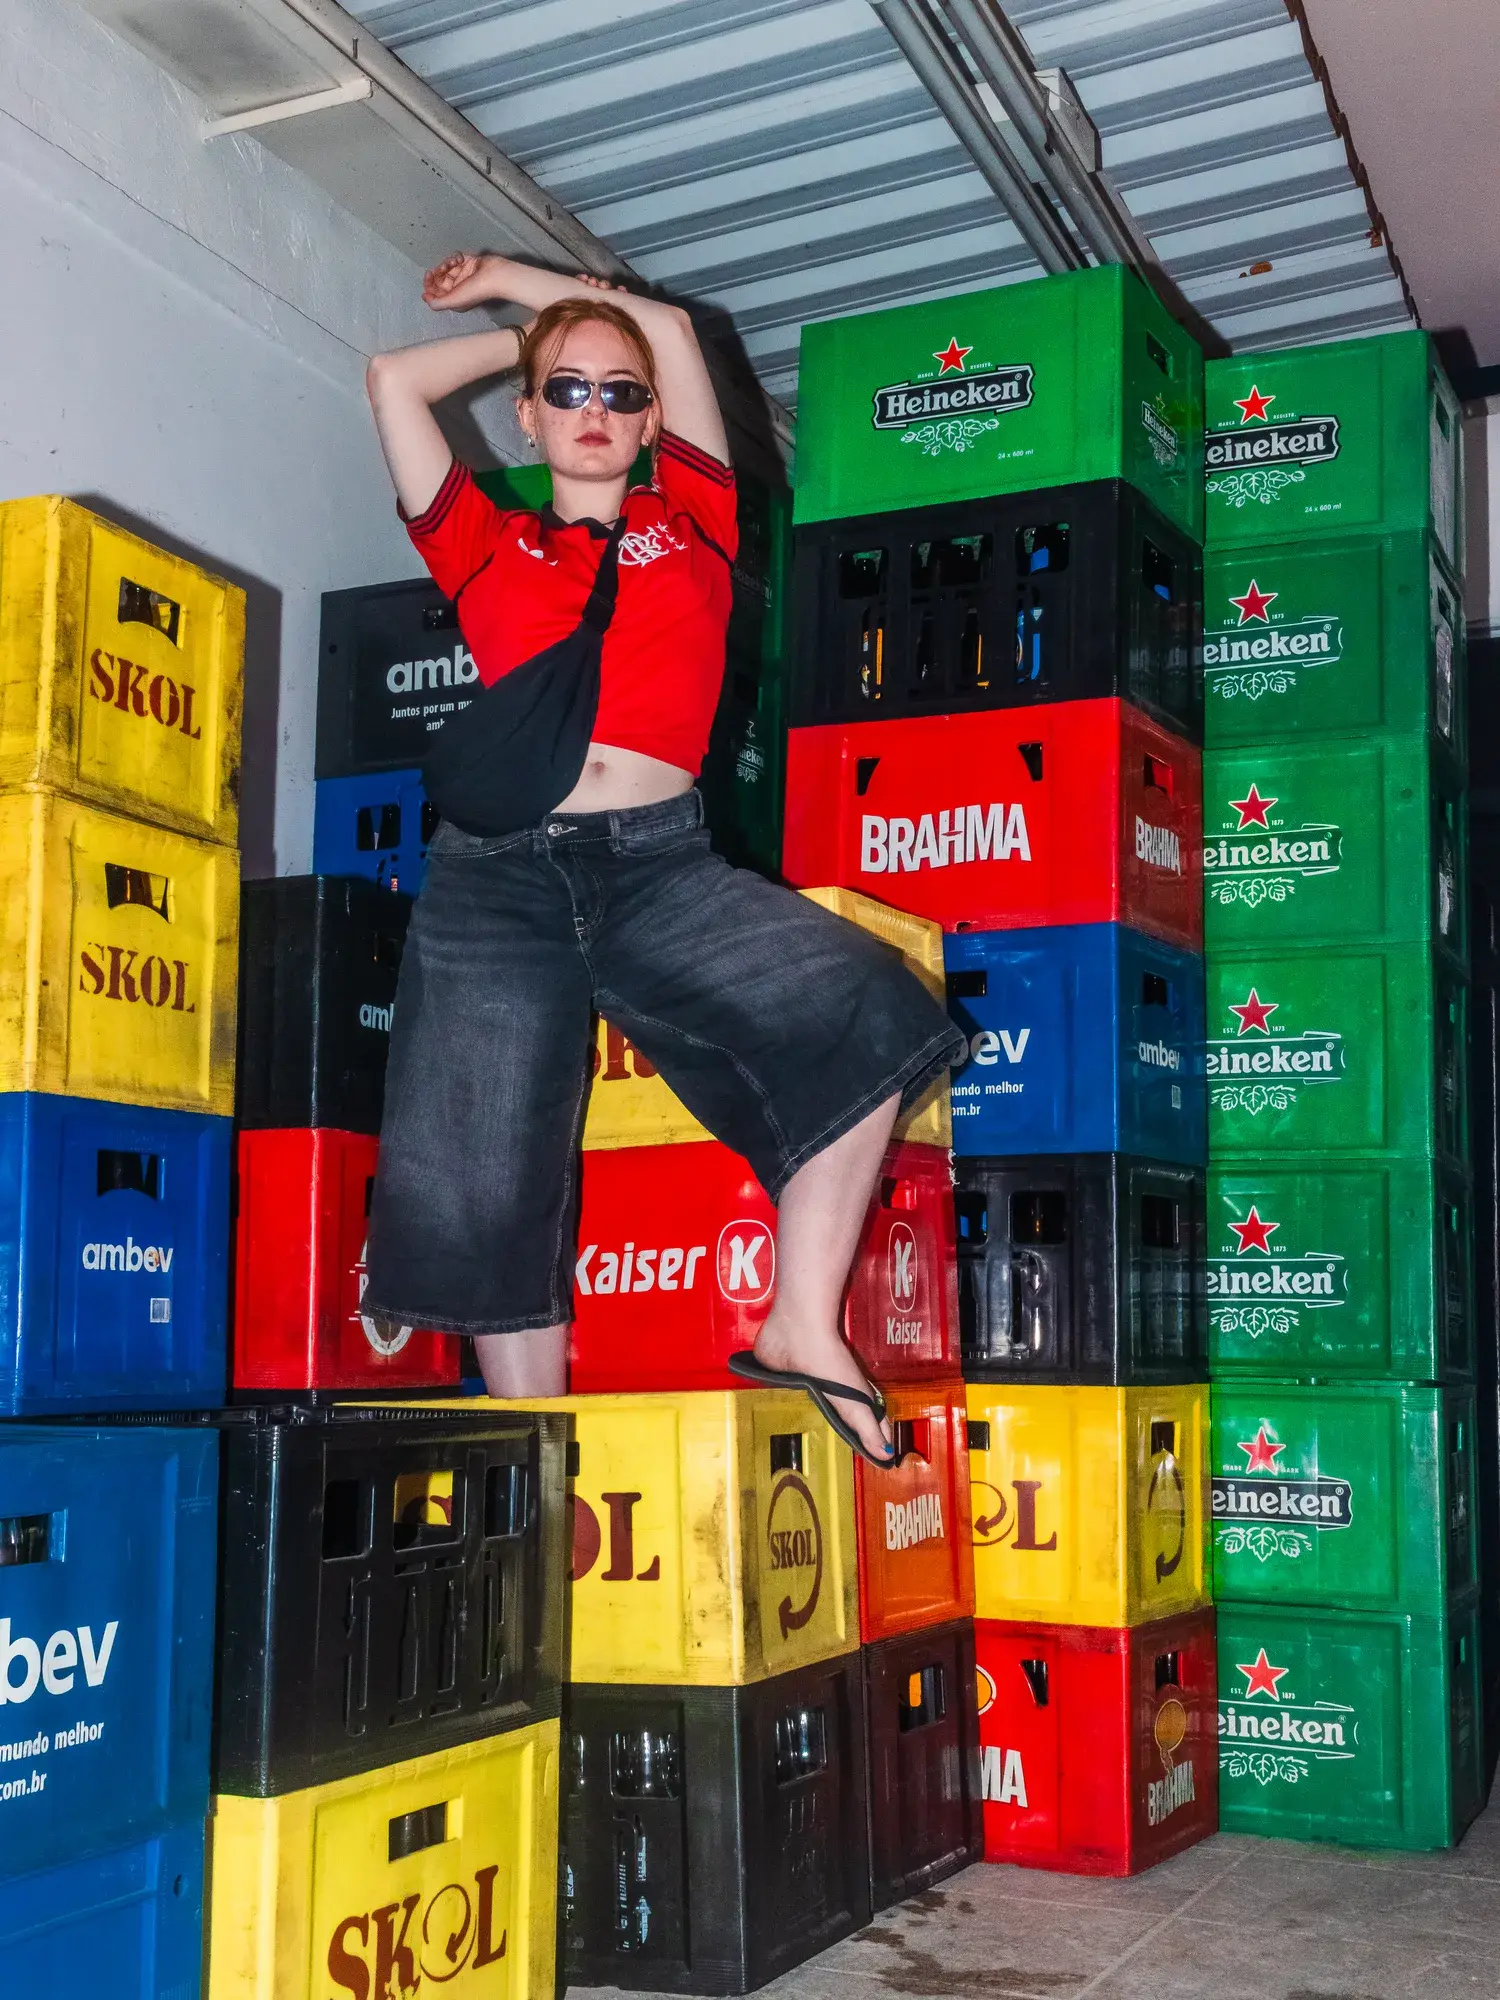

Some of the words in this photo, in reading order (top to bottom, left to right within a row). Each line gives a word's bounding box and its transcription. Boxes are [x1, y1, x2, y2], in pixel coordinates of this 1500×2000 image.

[1205, 432, 1326, 464] eineken
[1203, 631, 1331, 664] eineken
[90, 648, 201, 740] SKOL
[391, 706, 420, 719] Juntos
[423, 704, 438, 717] por
[440, 701, 455, 712] um
[861, 803, 1032, 874] BRAHMA
[1135, 815, 1181, 876] BRAHMA
[1203, 837, 1331, 867] eineken
[79, 942, 195, 1013] SKOL
[1139, 1040, 1180, 1070] ambev
[1206, 1045, 1333, 1075] eineken
[985, 1081, 1024, 1094] melhor
[82, 1236, 174, 1273] ambev
[729, 1234, 766, 1291] K
[1206, 1265, 1334, 1294] eineken
[886, 1316, 922, 1345] Kaiser
[1212, 1483, 1343, 1517] eineken
[885, 1493, 945, 1551] BRAHMA
[769, 1528, 817, 1570] SKOL
[54, 1721, 105, 1750] melhor
[1217, 1707, 1346, 1746] eineken
[1148, 1760, 1195, 1827] BRAHMA
[328, 1865, 507, 2000] SKOL
